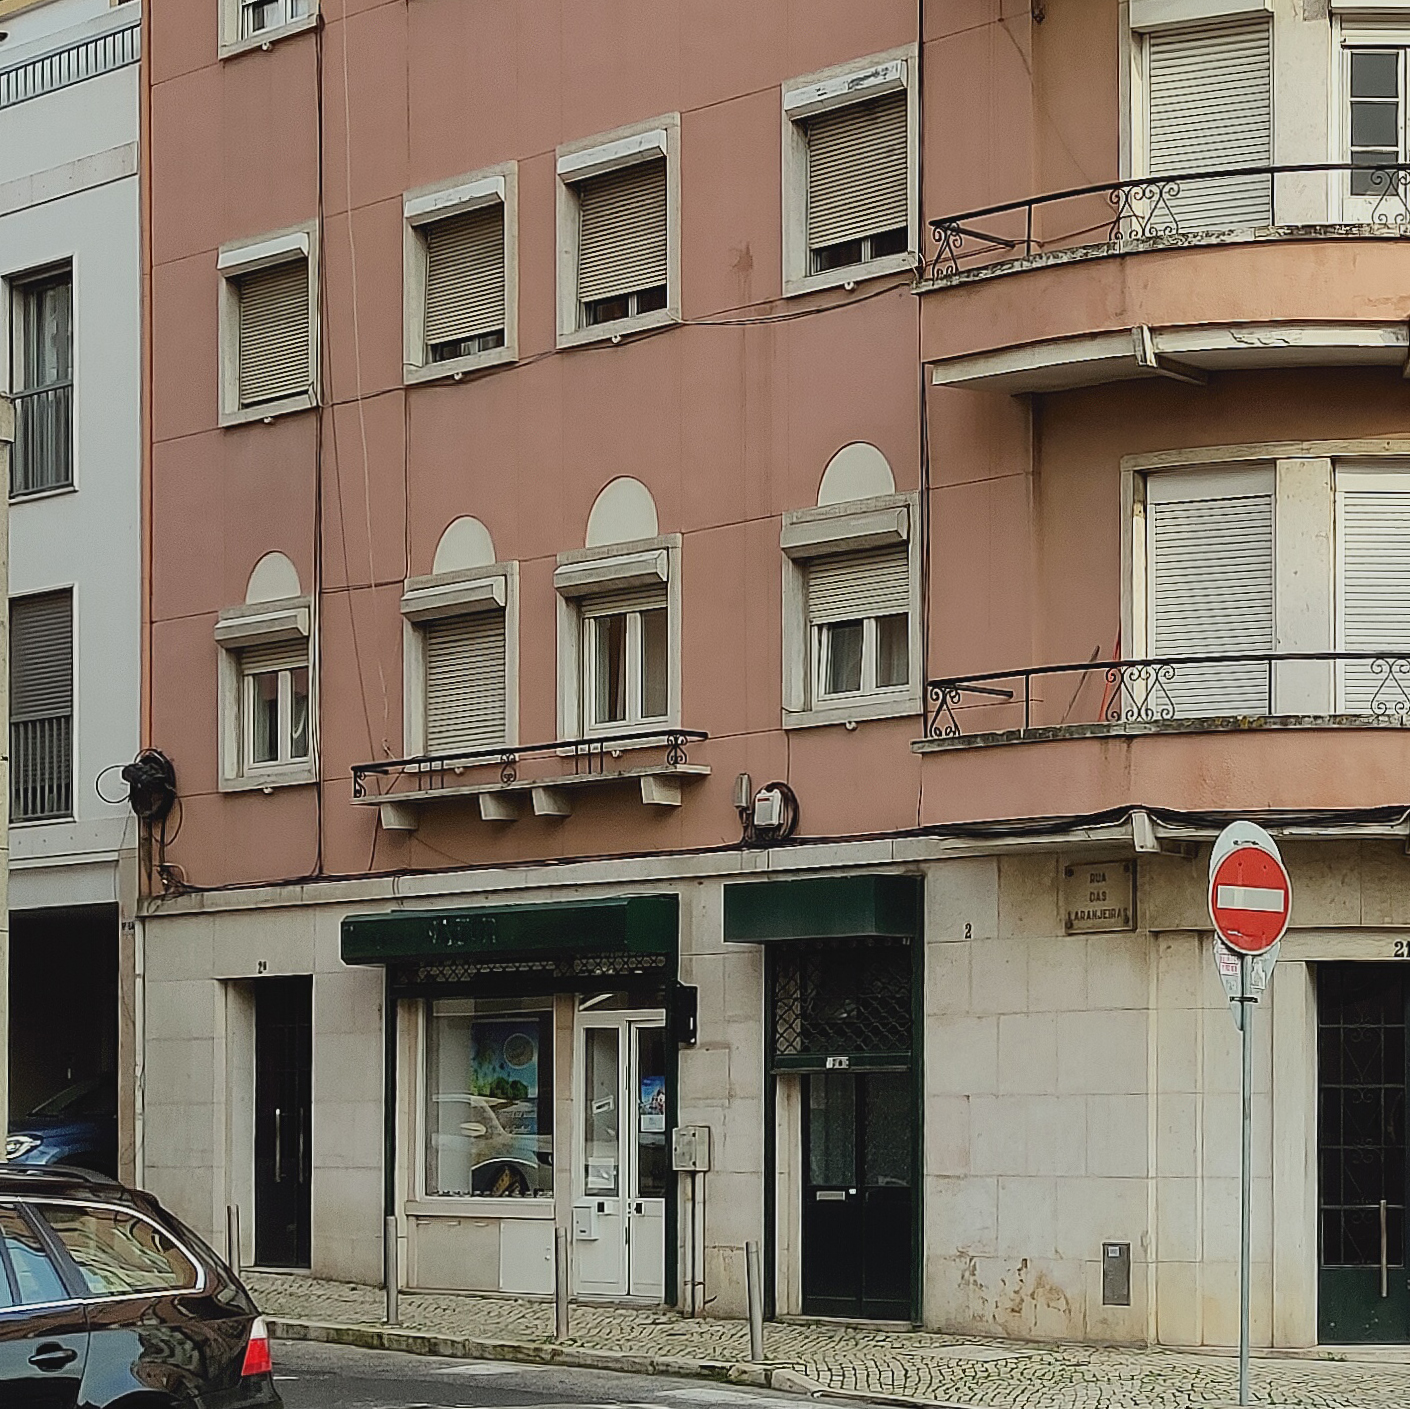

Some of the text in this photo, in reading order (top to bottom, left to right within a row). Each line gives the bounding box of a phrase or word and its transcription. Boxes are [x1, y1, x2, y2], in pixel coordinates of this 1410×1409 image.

[1089, 872, 1107, 884] RUA
[1089, 891, 1107, 903] DAS
[1067, 908, 1128, 922] LARANJEIRAS
[964, 922, 972, 939] 2
